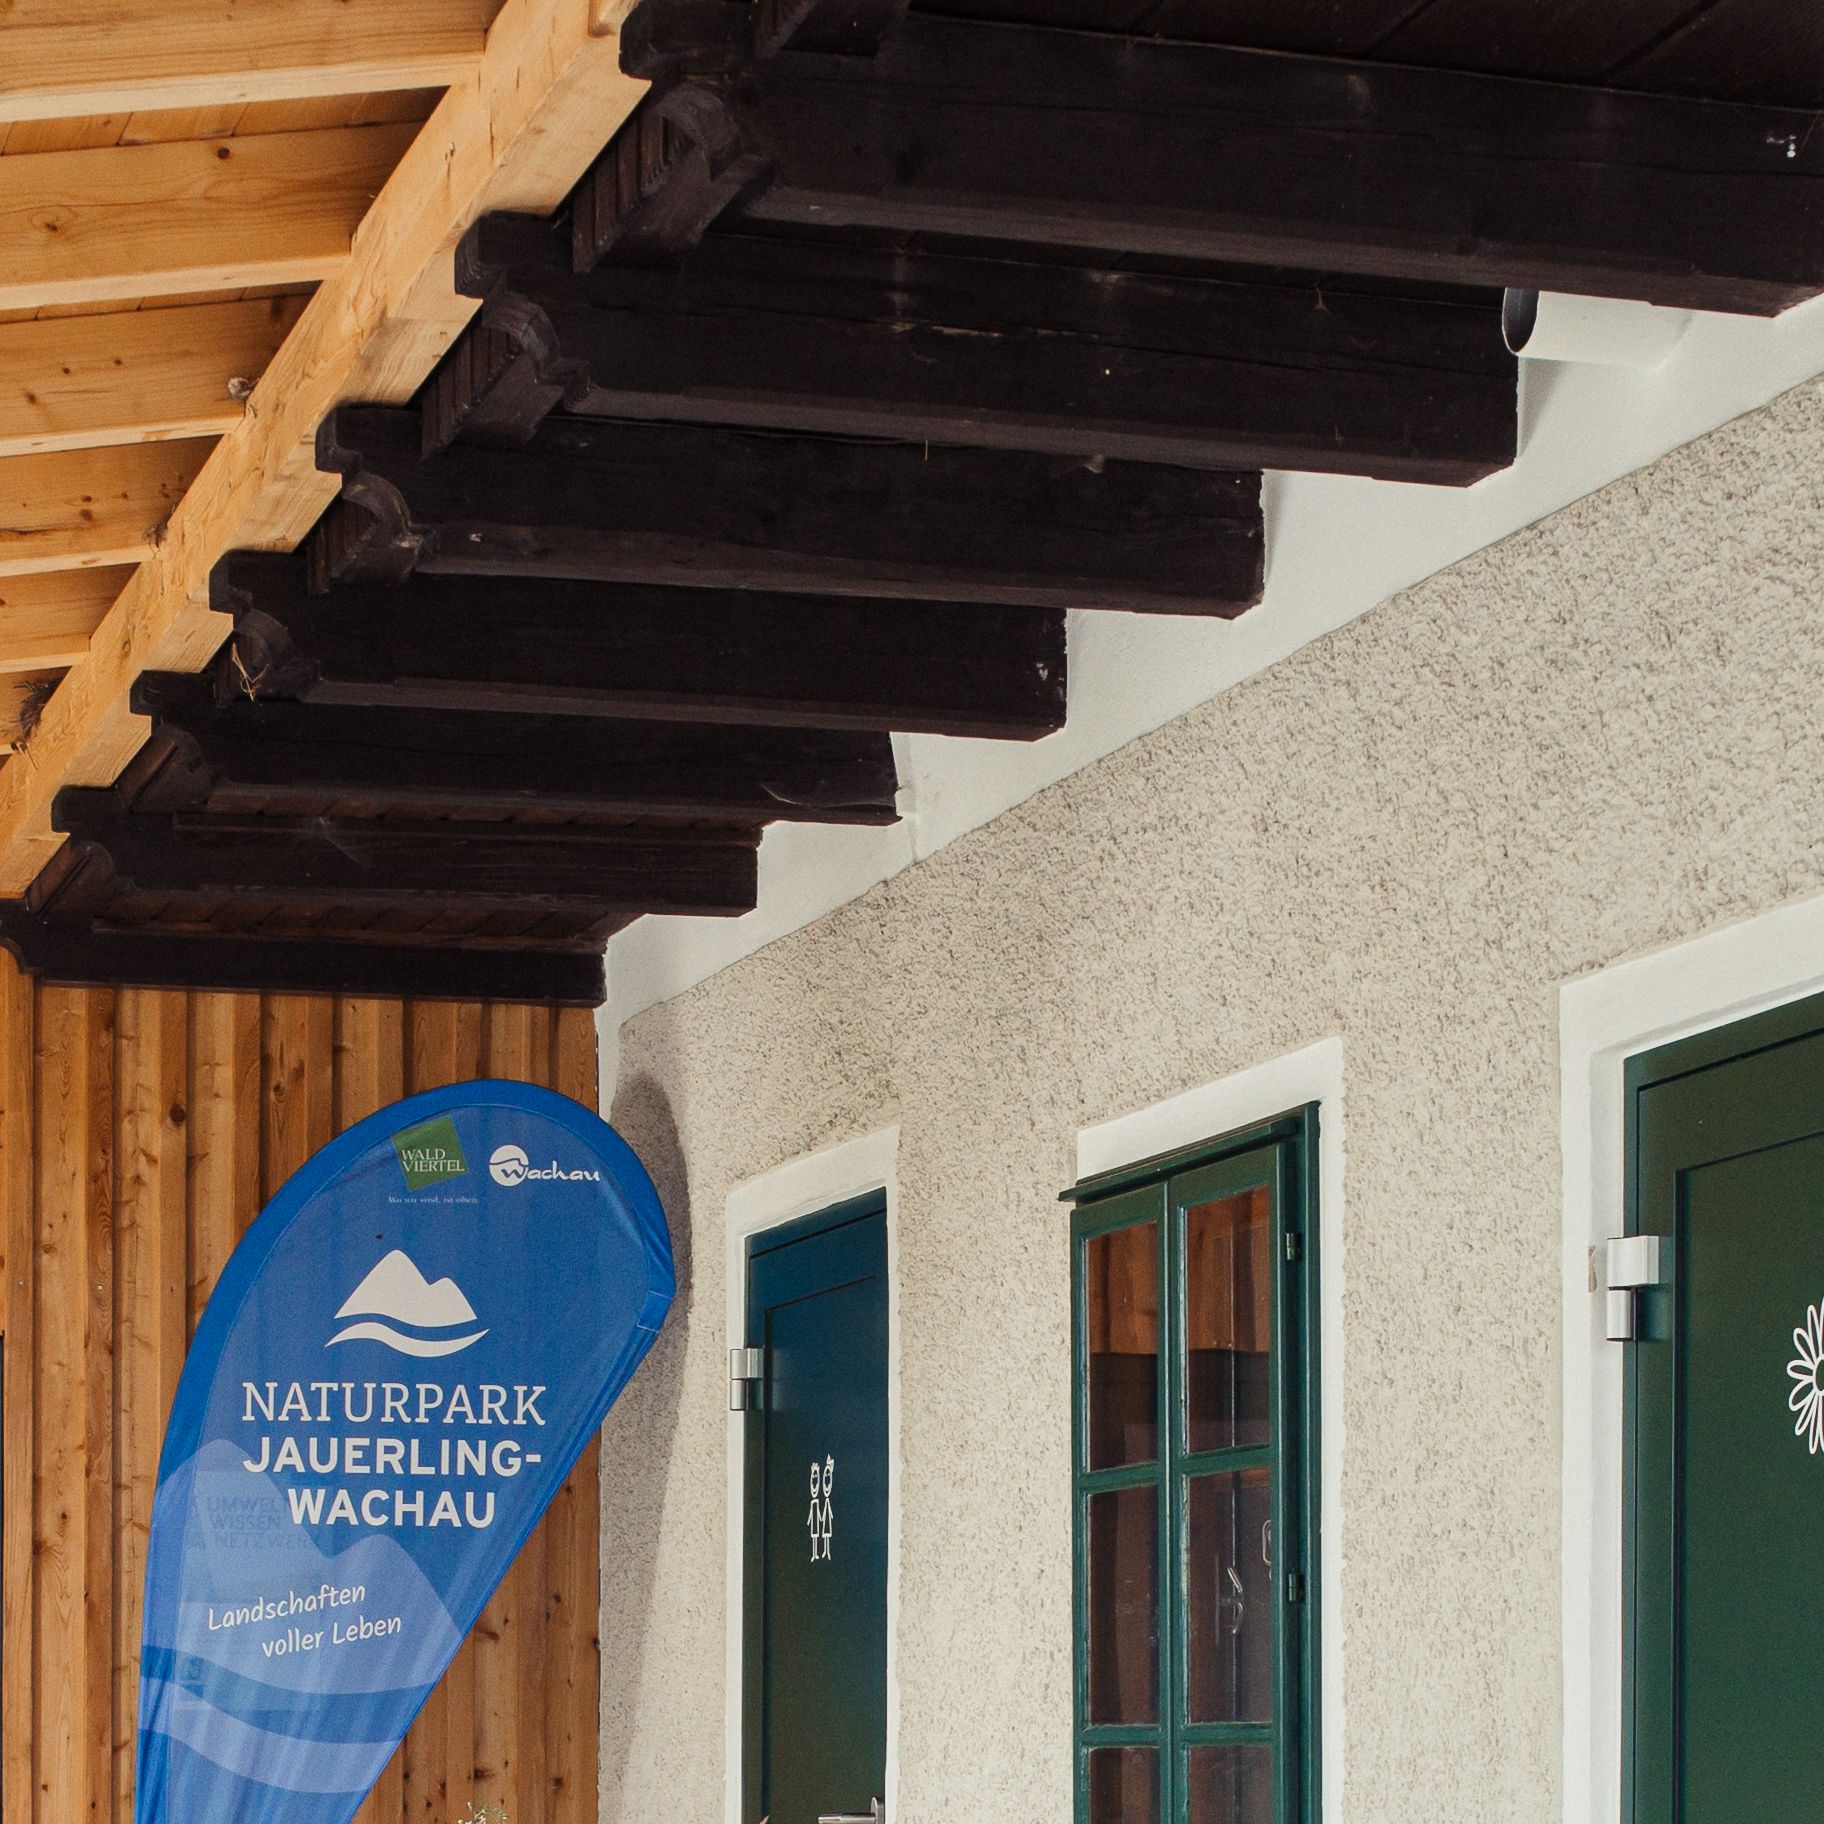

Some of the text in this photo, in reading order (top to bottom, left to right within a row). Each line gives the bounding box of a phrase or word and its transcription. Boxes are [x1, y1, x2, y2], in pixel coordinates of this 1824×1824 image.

[401, 1148, 446, 1161] WALD
[401, 1159, 465, 1173] VIERTEL
[500, 1160, 601, 1182] Wachau
[242, 1382, 547, 1425] NATURPARK
[242, 1436, 542, 1477] JAUERLING-
[287, 1488, 495, 1528] WACHAU
[208, 1584, 366, 1632] Landschaften
[261, 1615, 401, 1657] voller Leben
